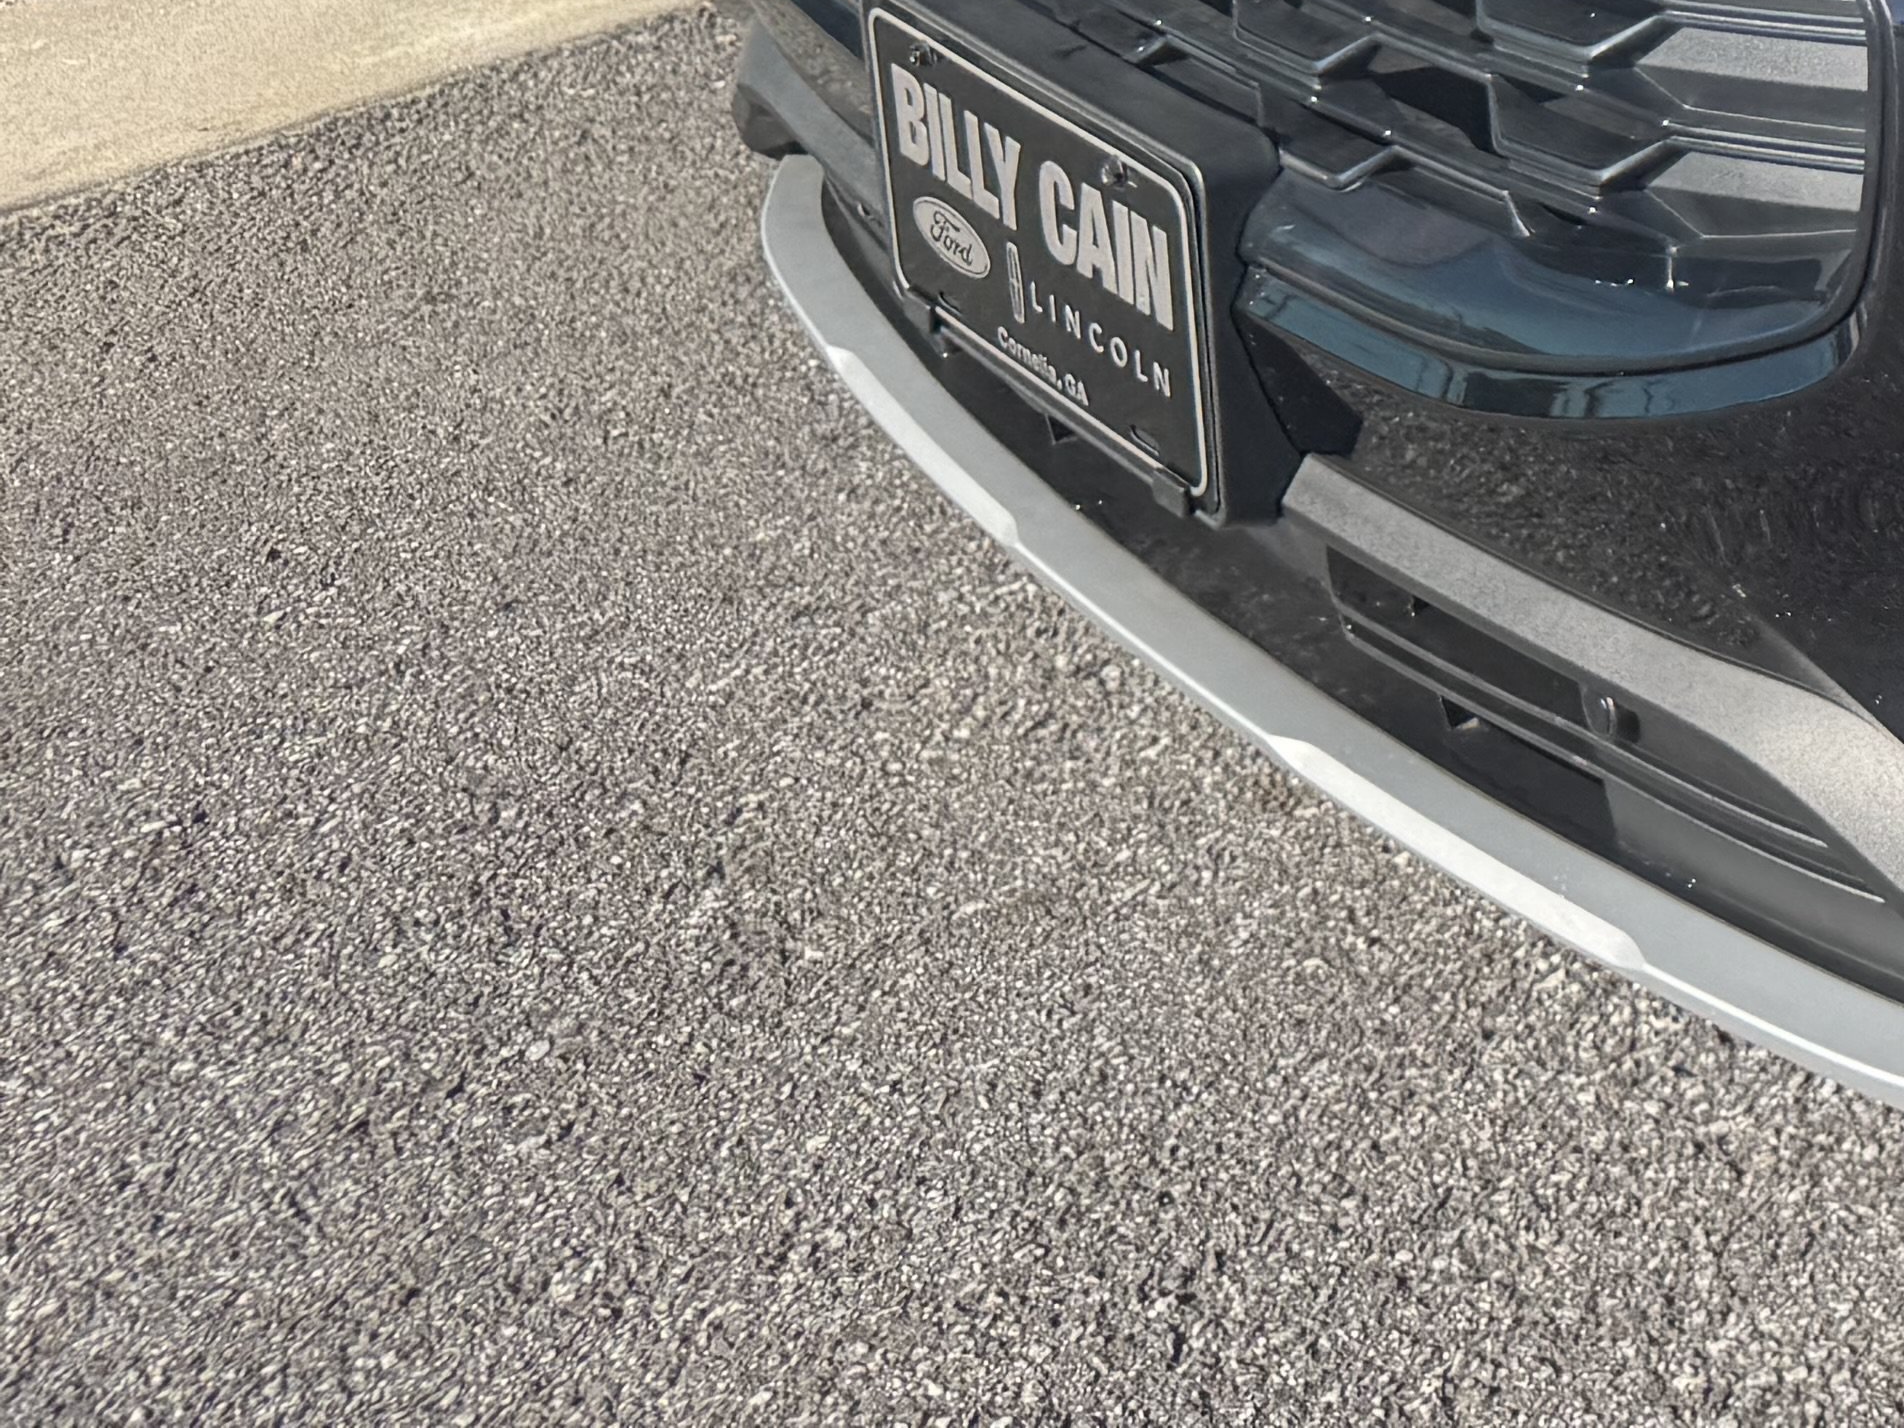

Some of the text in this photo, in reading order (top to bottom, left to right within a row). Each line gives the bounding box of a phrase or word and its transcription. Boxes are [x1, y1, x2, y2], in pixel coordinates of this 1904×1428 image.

[890, 63, 1175, 332] BILLY CAIN
[929, 210, 976, 266] Ford
[1029, 280, 1171, 398] LINCOLN
